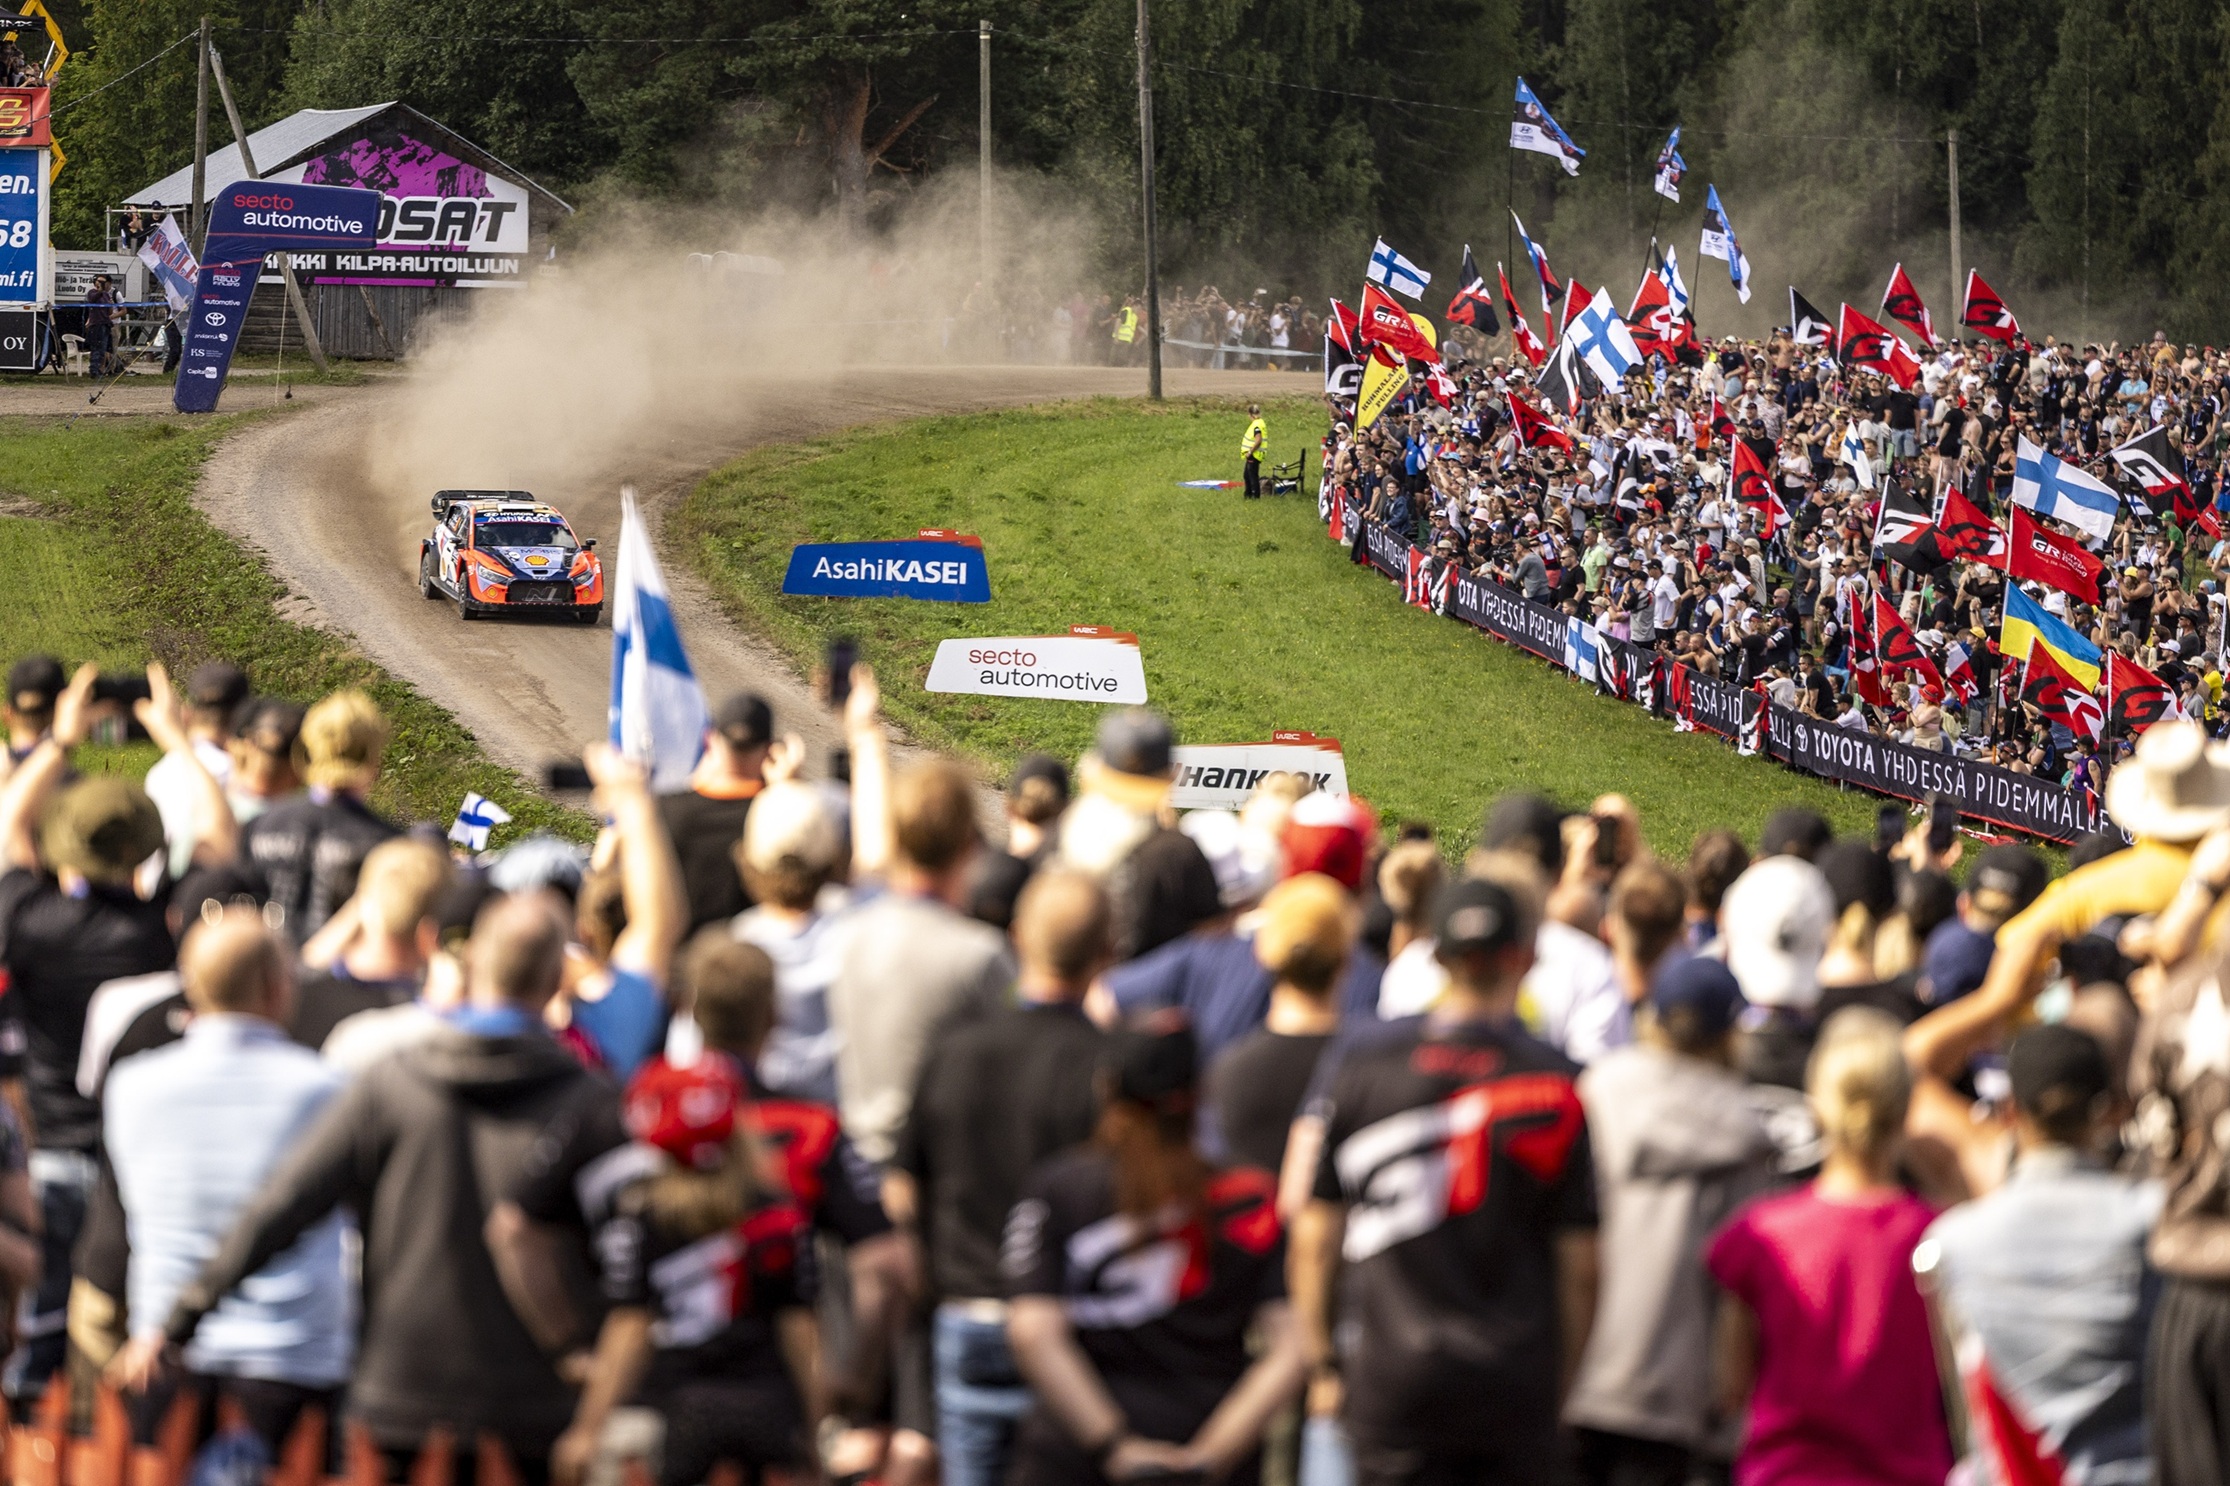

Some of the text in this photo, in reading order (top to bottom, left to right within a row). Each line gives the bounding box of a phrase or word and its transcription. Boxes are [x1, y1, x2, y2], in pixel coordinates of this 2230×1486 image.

[233, 193, 294, 211] secto
[243, 211, 363, 234] automotive
[336, 254, 519, 274] KILPA-AUTOILUUN
[3, 336, 27, 350] OY
[2031, 538, 2061, 559] GR
[1074, 626, 1098, 634] WRC
[968, 648, 1037, 667] secto
[979, 668, 1118, 692] automotive
[1812, 727, 1876, 775] TOYOTA
[1882, 747, 1967, 799] YHDESSÄ
